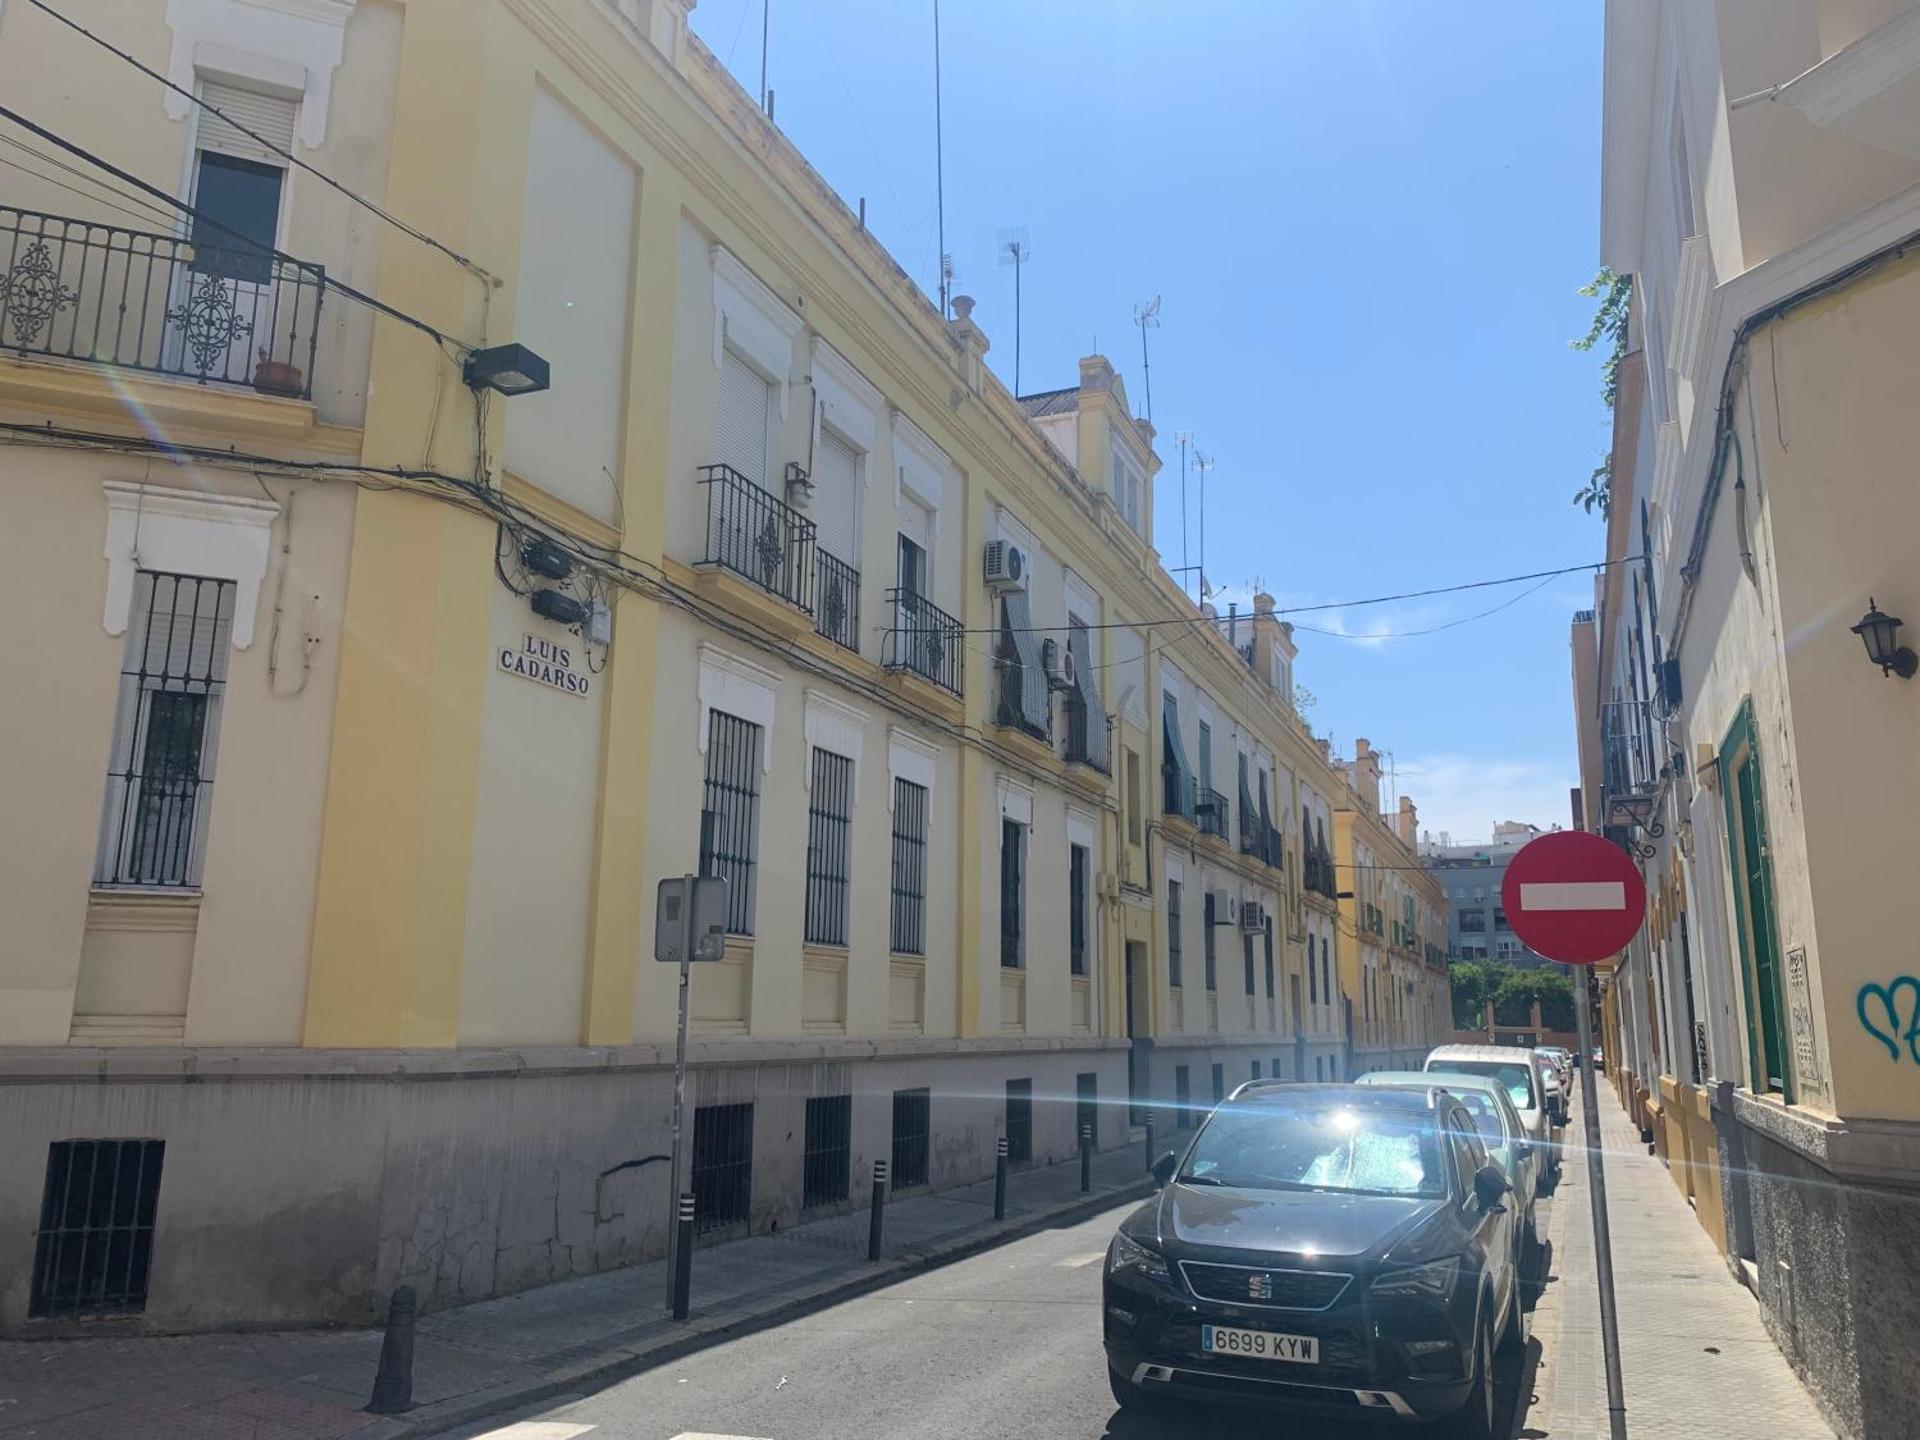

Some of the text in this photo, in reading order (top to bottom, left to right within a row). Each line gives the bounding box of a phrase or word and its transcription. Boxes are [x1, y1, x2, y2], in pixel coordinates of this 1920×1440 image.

[527, 636, 570, 667] LUIS
[501, 650, 589, 694] CADARSO
[1215, 1330, 1312, 1360] 6699 KYW
